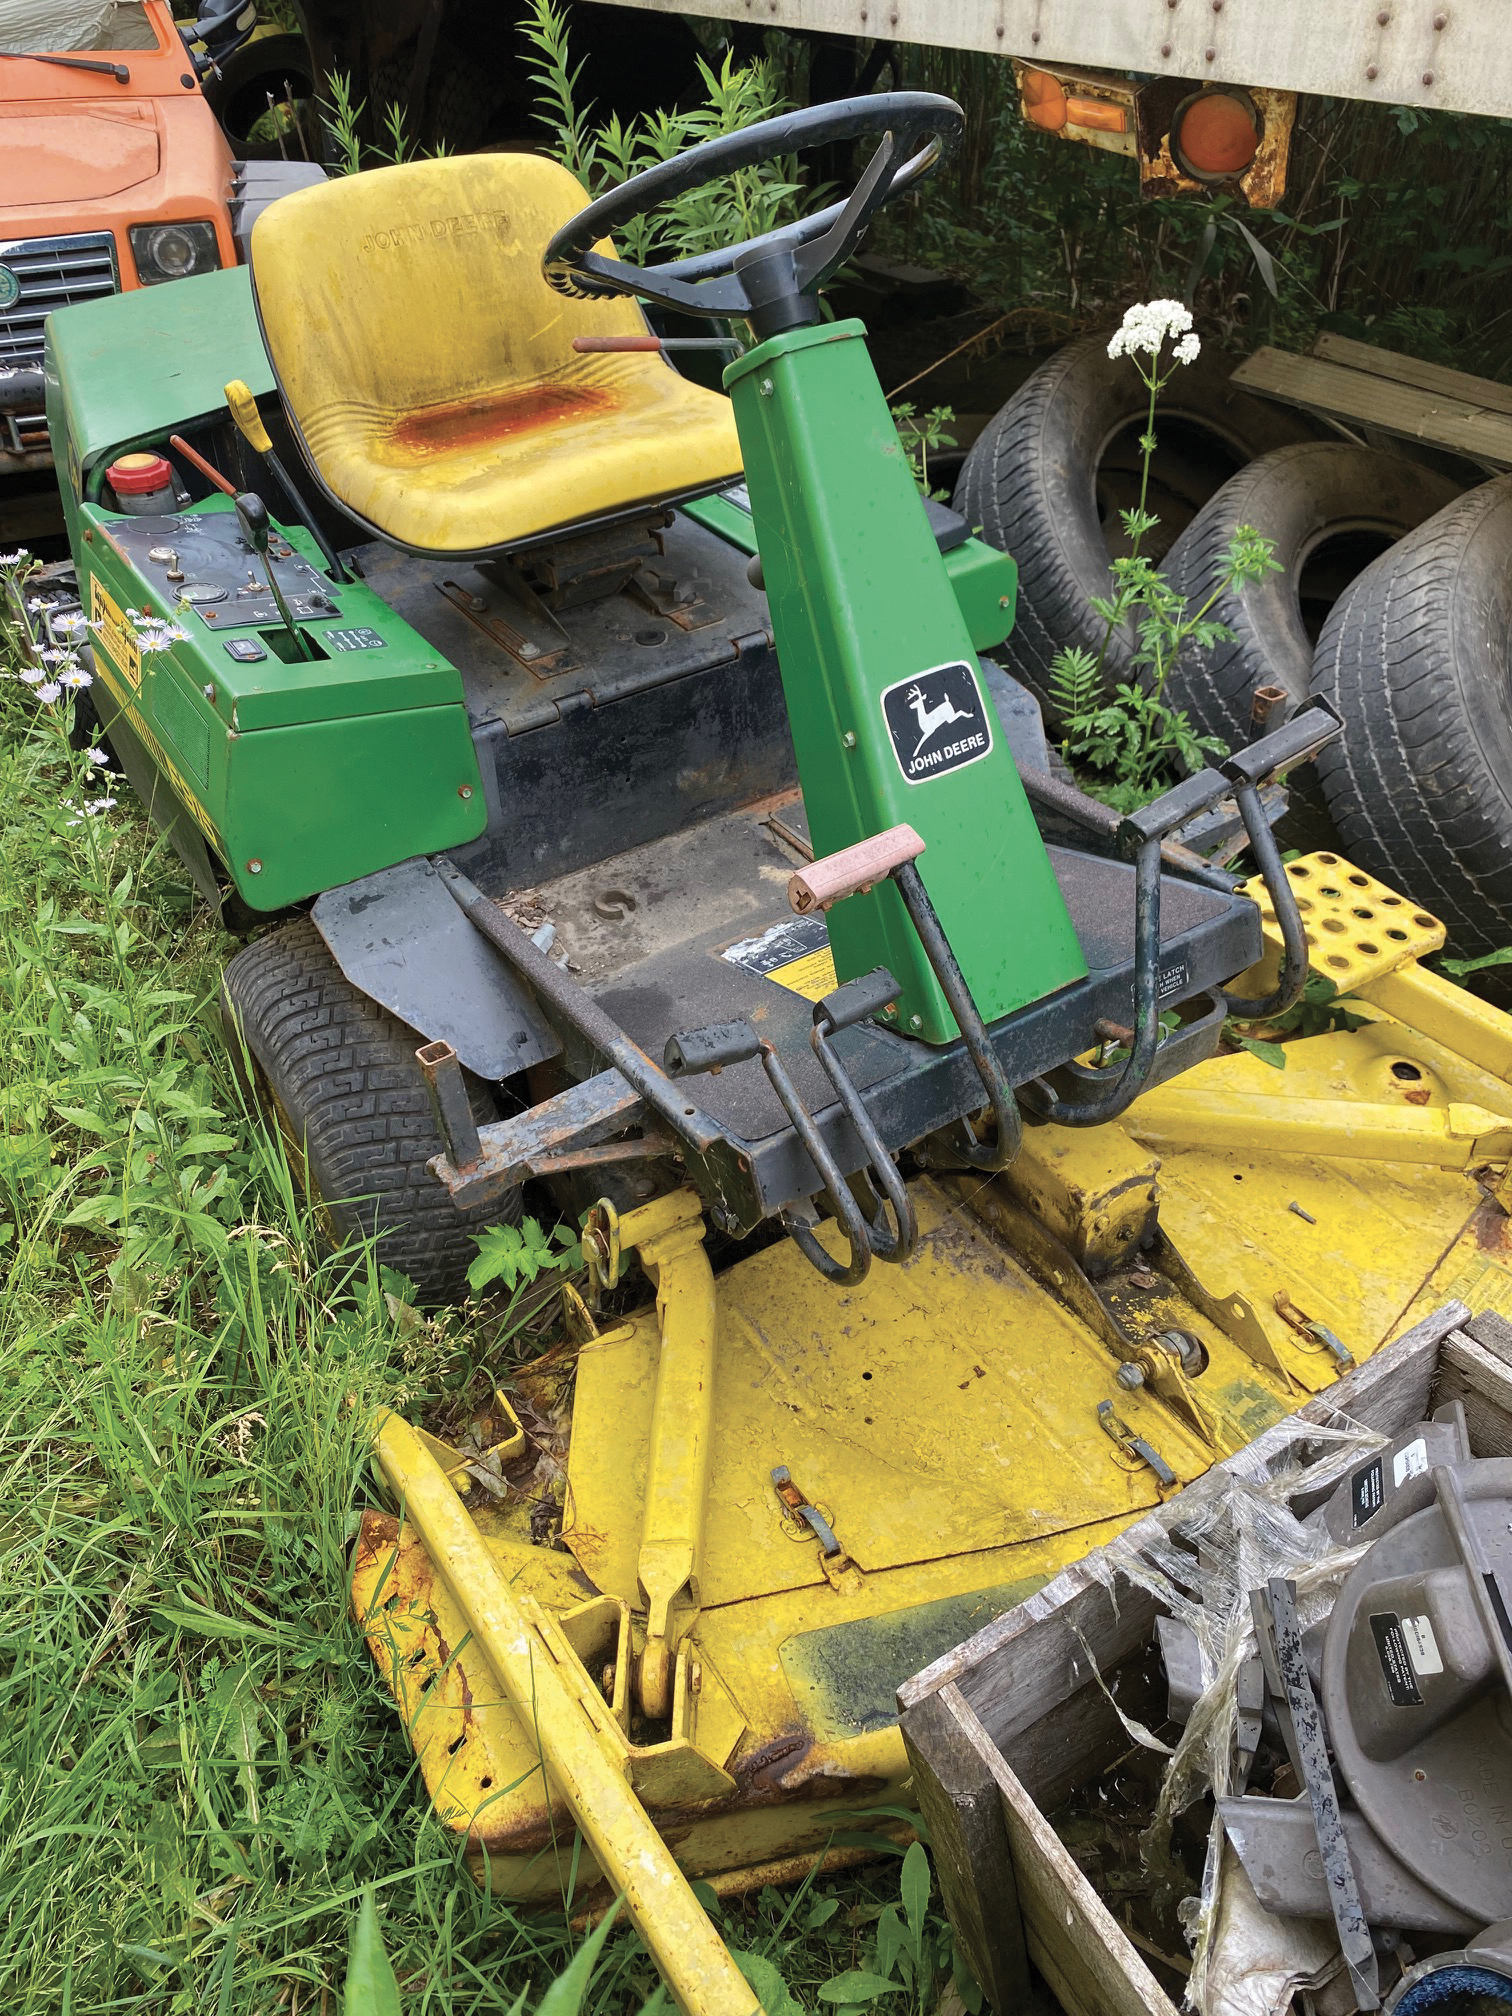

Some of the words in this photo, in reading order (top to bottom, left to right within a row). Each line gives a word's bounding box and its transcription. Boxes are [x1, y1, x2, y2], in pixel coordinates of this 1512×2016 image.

[363, 224, 424, 253] JOHN
[430, 210, 512, 238] DEERE
[908, 750, 943, 774] JOHN
[943, 733, 985, 760] DEERE
[1160, 979, 1183, 993] VEHICLE
[1163, 965, 1185, 979] LATCH
[1165, 974, 1181, 986] WHEN
[1385, 1636, 1395, 1659] UNITED
[1392, 1659, 1401, 1684] STATES
[1390, 1627, 1402, 1665] FOLLOWING
[1394, 1628, 1407, 1666] PROTECTED
[1404, 1666, 1410, 1675] BY
[1471, 1742, 1500, 1794] MADE
[1490, 1805, 1511, 1825] IN
